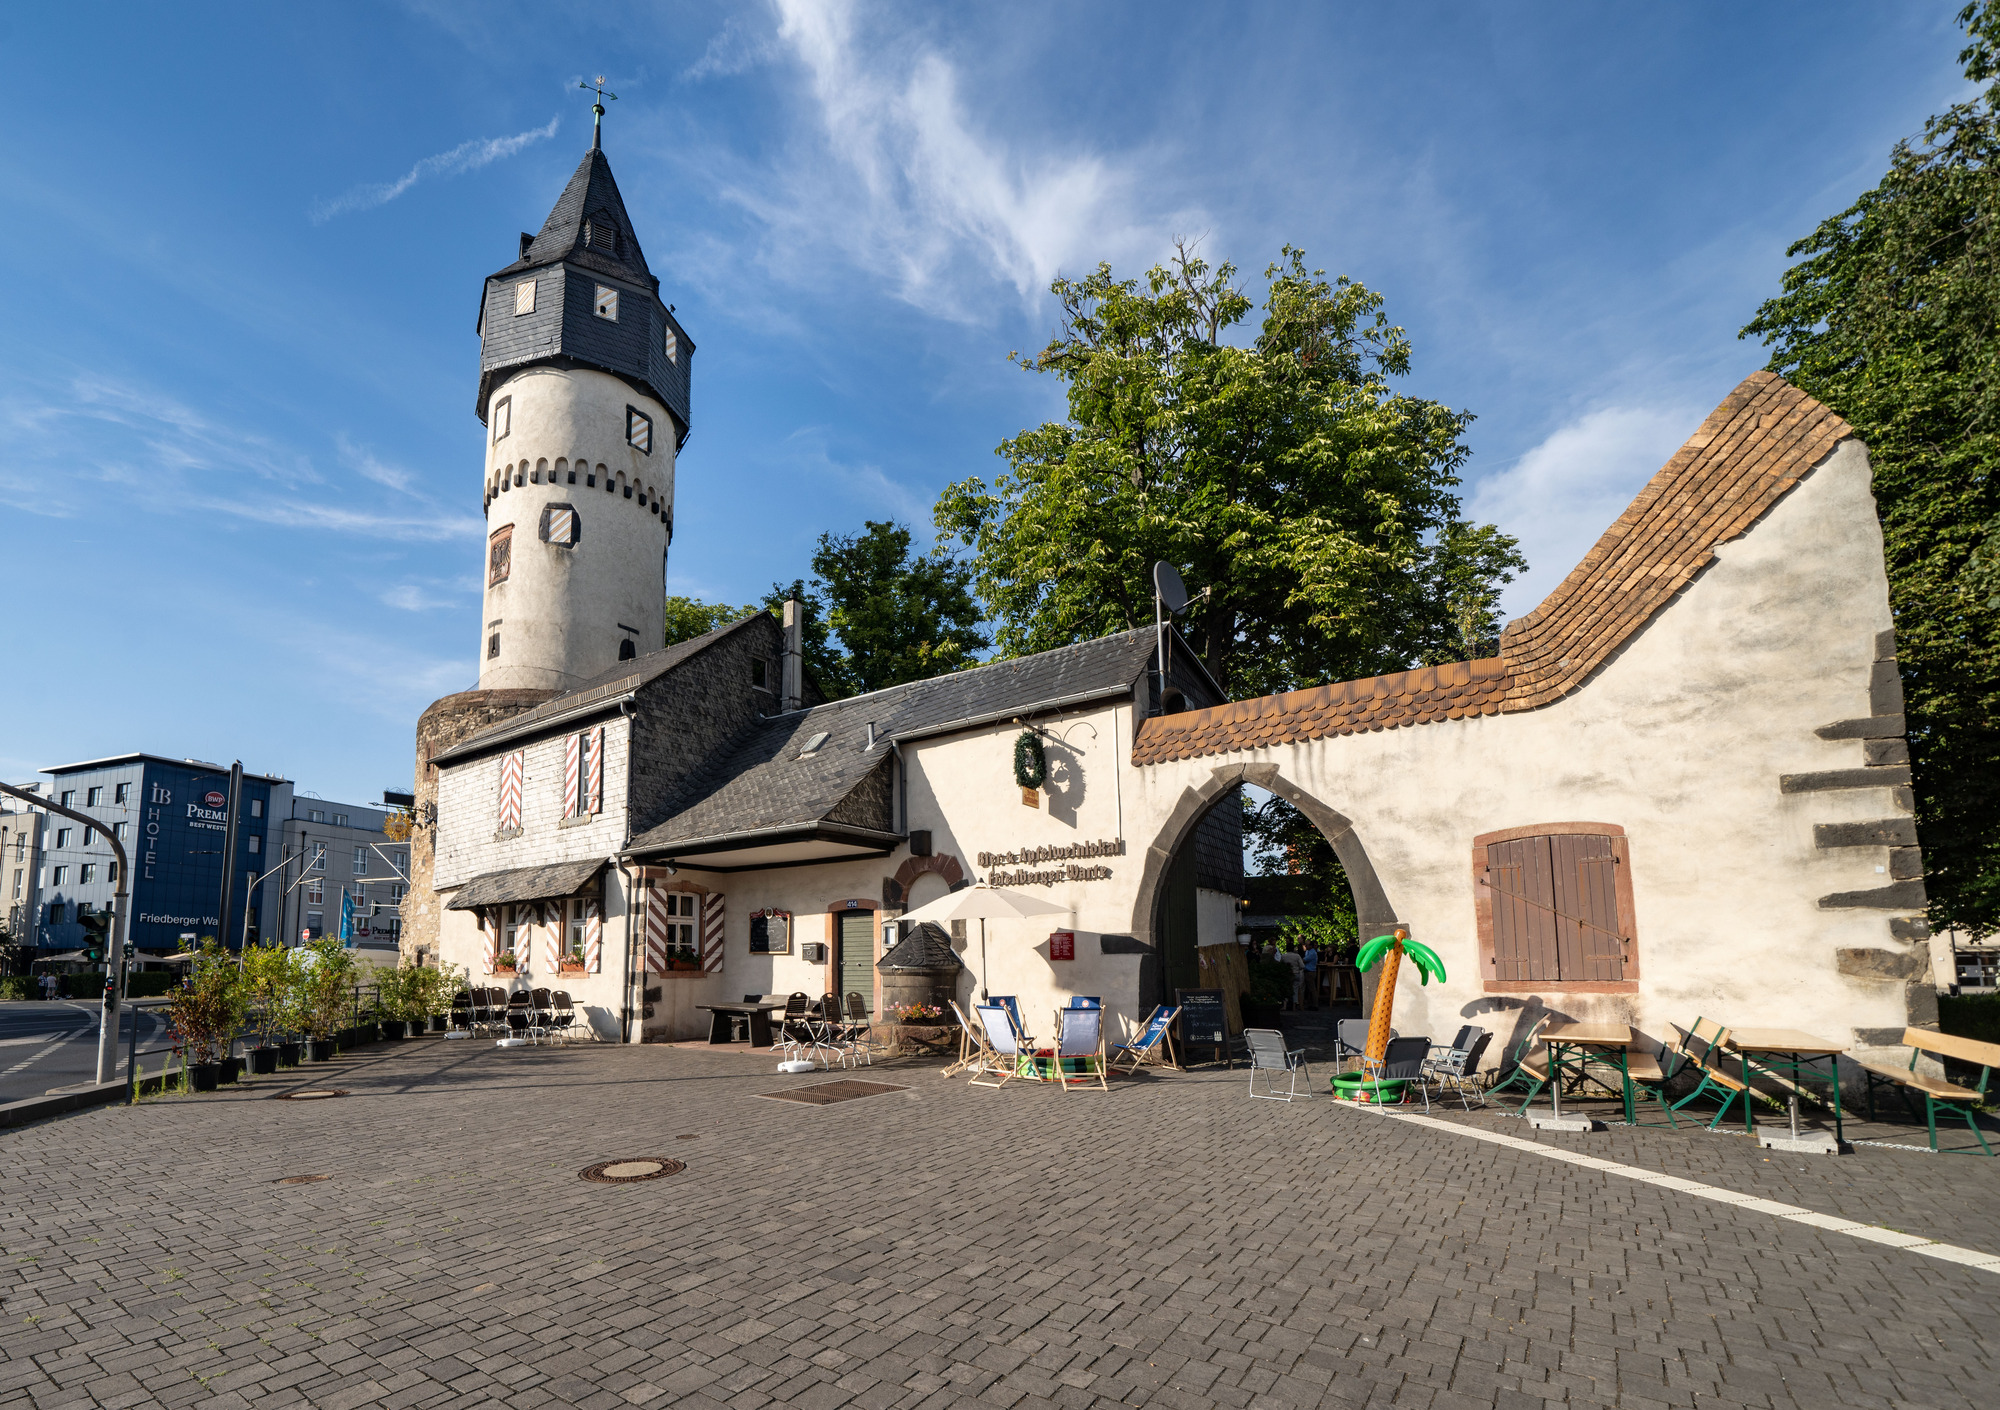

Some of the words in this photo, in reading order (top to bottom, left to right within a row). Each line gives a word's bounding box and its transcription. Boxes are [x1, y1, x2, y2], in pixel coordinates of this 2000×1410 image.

[186, 803, 241, 824] PREMI
[144, 807, 160, 879] HOTEL
[978, 851, 1002, 867] Bier
[1006, 850, 1015, 863] &
[1020, 837, 1120, 866] Apfelweinlokal
[988, 868, 1062, 885] Friedberger
[1066, 864, 1108, 880] Warte
[139, 912, 200, 927] Friedberger
[202, 916, 219, 926] Wa
